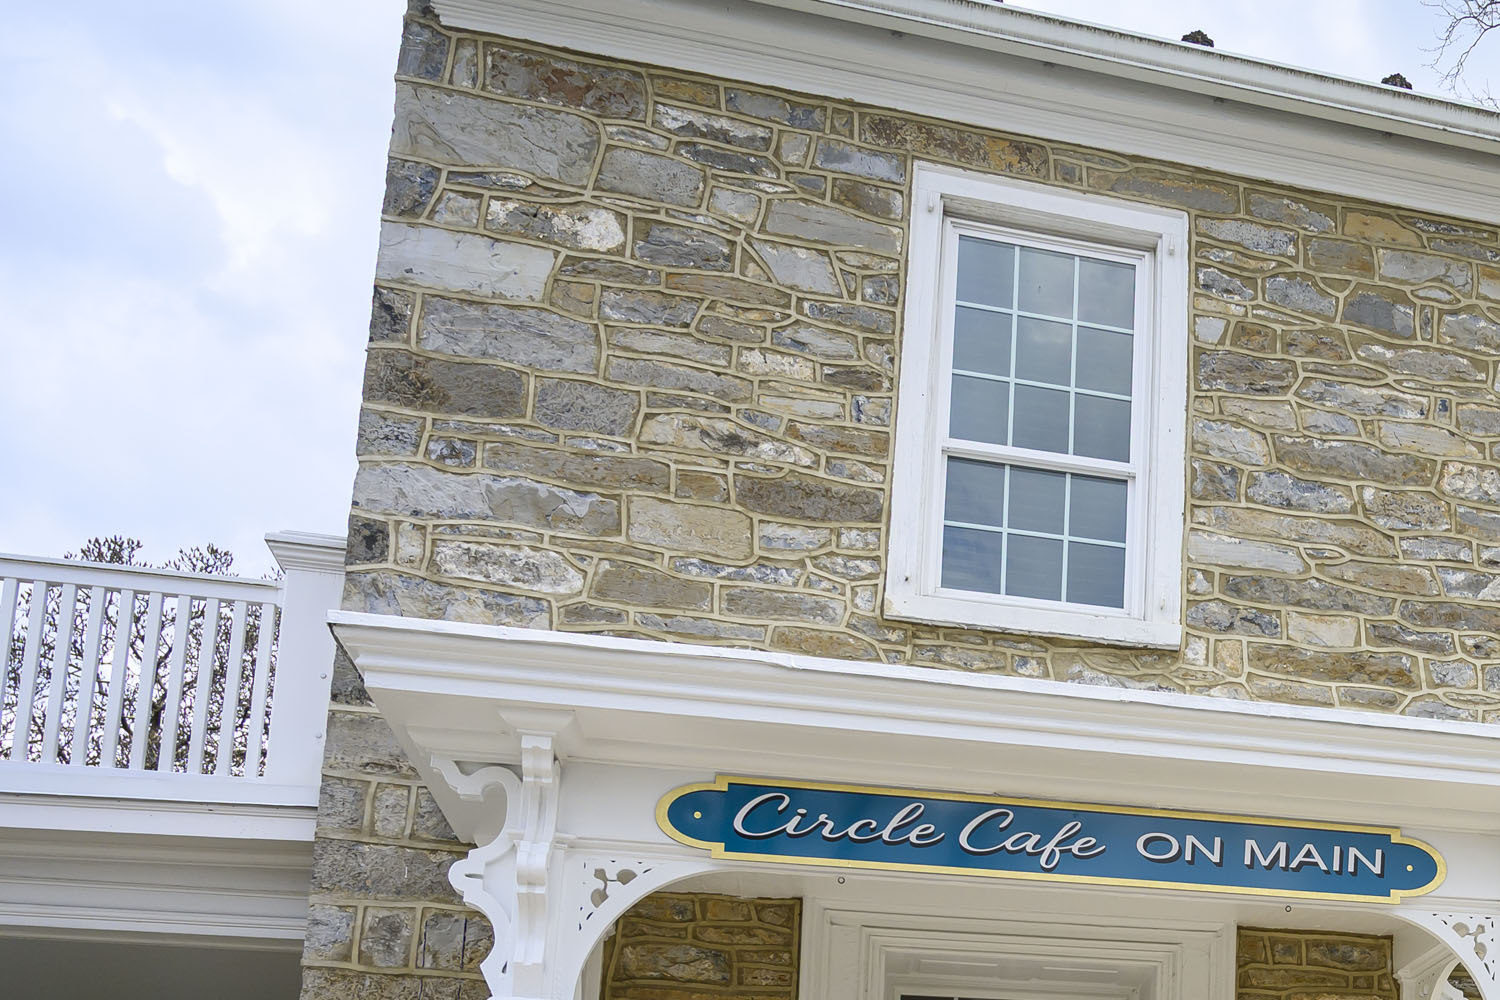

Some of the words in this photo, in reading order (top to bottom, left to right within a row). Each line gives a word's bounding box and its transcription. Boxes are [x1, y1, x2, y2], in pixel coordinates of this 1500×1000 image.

[732, 792, 945, 845] Circle
[958, 808, 1106, 869] Cafe
[1136, 831, 1223, 865] ON
[1243, 838, 1386, 877] MAIN
